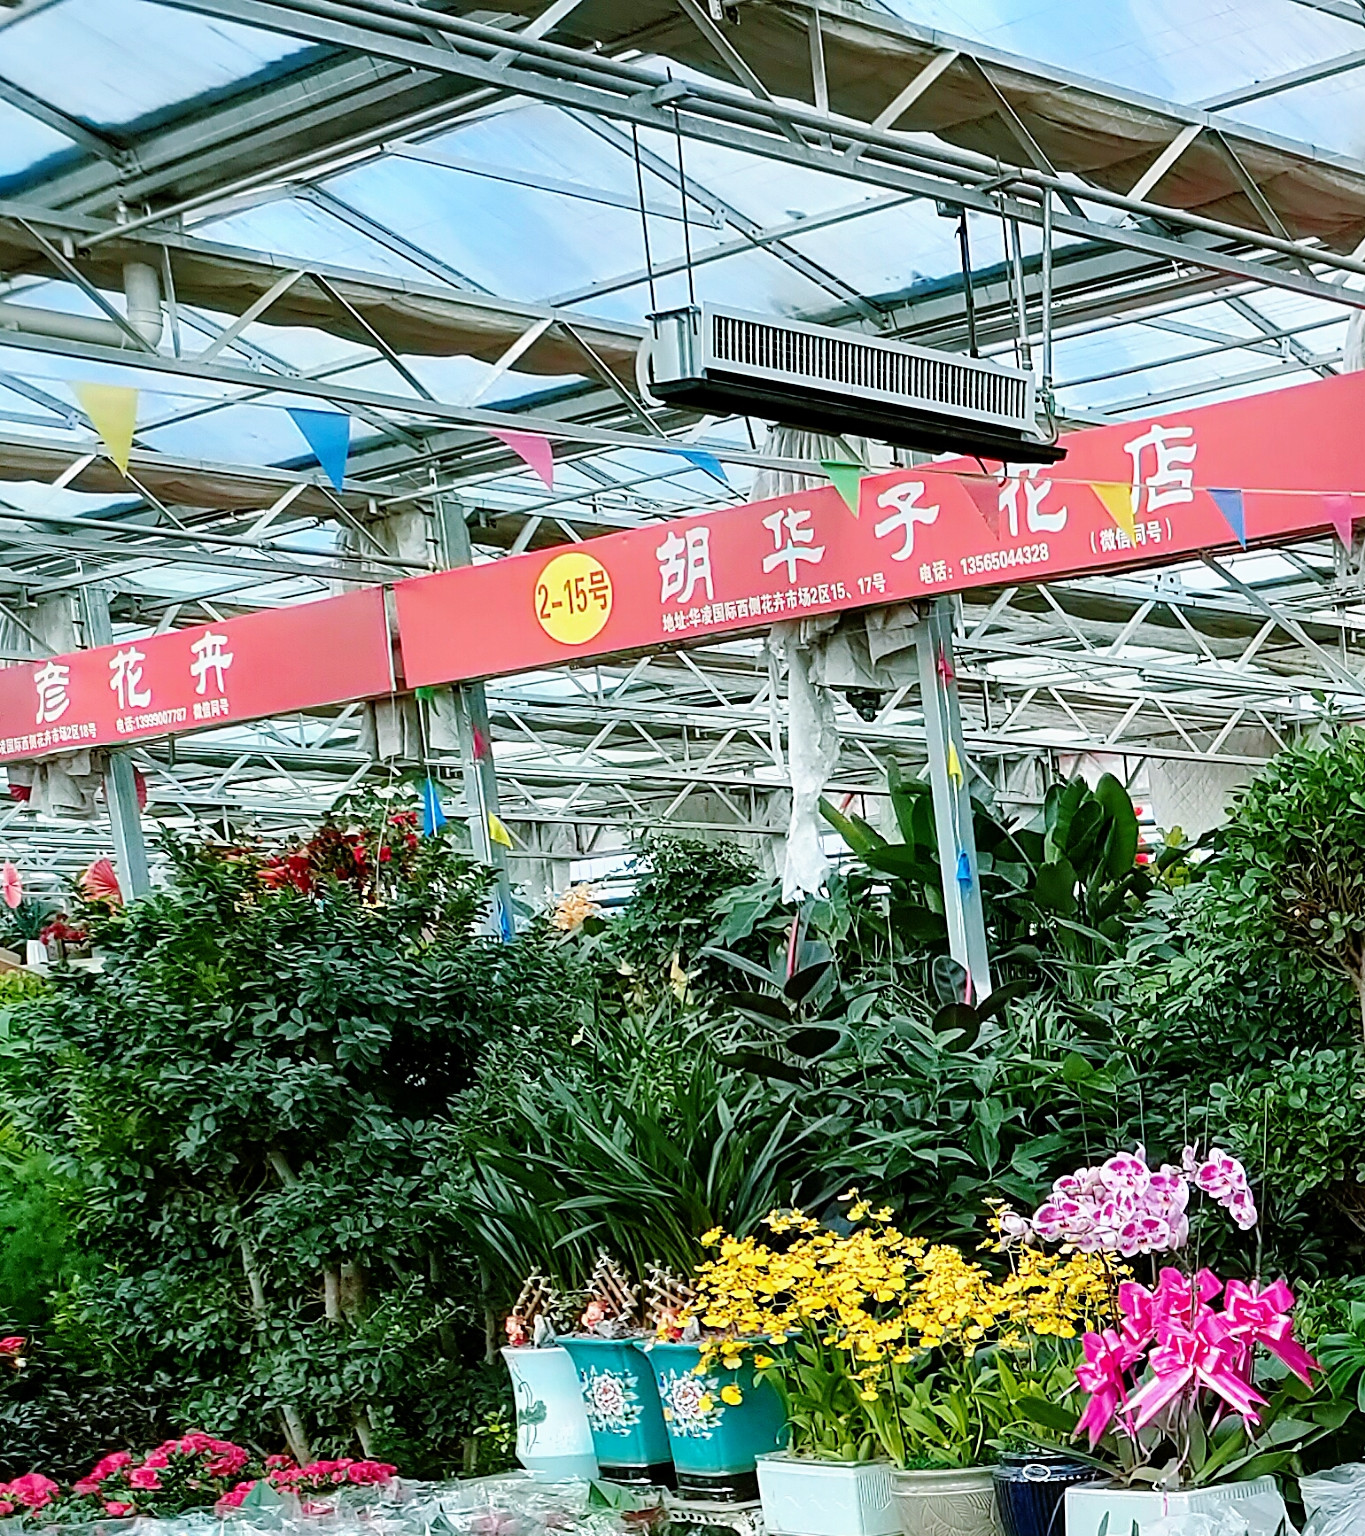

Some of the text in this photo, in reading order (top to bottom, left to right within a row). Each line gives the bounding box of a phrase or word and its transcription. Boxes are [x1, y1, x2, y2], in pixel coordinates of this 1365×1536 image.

[656, 424, 1197, 604] 胡华子花店
[538, 570, 608, 619] 2-15号
[662, 572, 886, 633] 地址:华凌国际西侧花卉市场2区15、17号
[34, 631, 234, 724] 彦花卉
